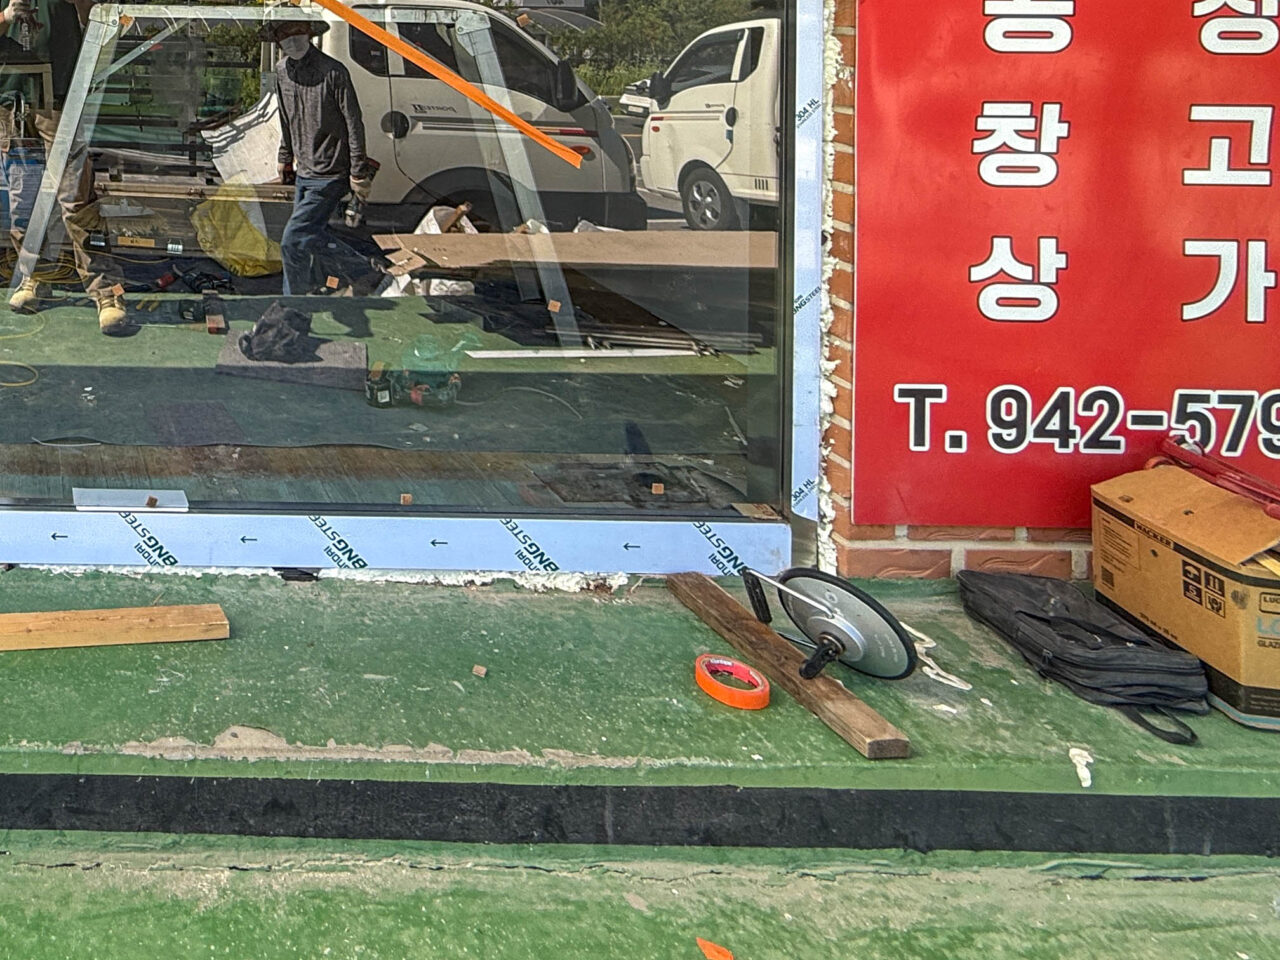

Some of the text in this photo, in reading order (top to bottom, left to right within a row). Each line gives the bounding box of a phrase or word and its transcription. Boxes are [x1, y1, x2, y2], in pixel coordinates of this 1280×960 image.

[807, 98, 820, 109] HL
[971, 101, 1275, 188] 창 고
[969, 236, 1277, 323] 상 가
[894, 382, 968, 453] T.
[803, 479, 815, 490] HL
